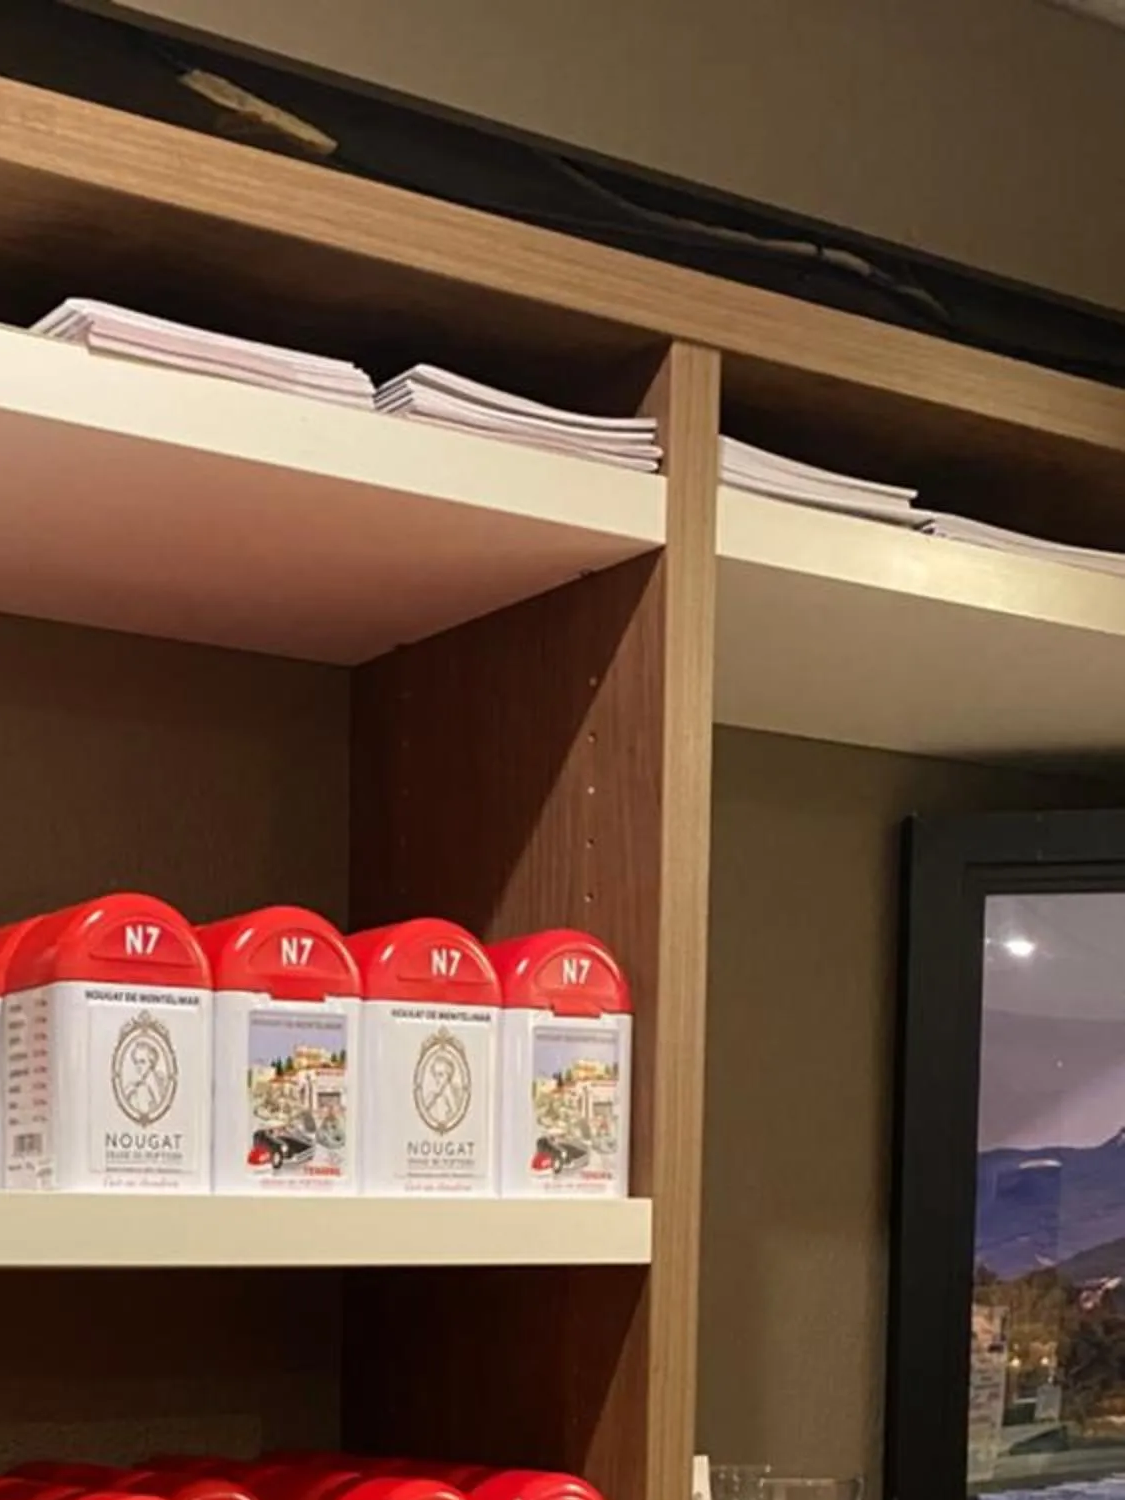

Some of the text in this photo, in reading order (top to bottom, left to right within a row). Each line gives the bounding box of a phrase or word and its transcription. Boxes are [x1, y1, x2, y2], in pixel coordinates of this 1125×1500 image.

[125, 924, 160, 955] N7
[281, 937, 313, 966] N7
[431, 947, 462, 977] N7
[562, 958, 592, 985] N7
[105, 1132, 182, 1150] NOUGAT
[407, 1141, 475, 1156] NOUGAT
